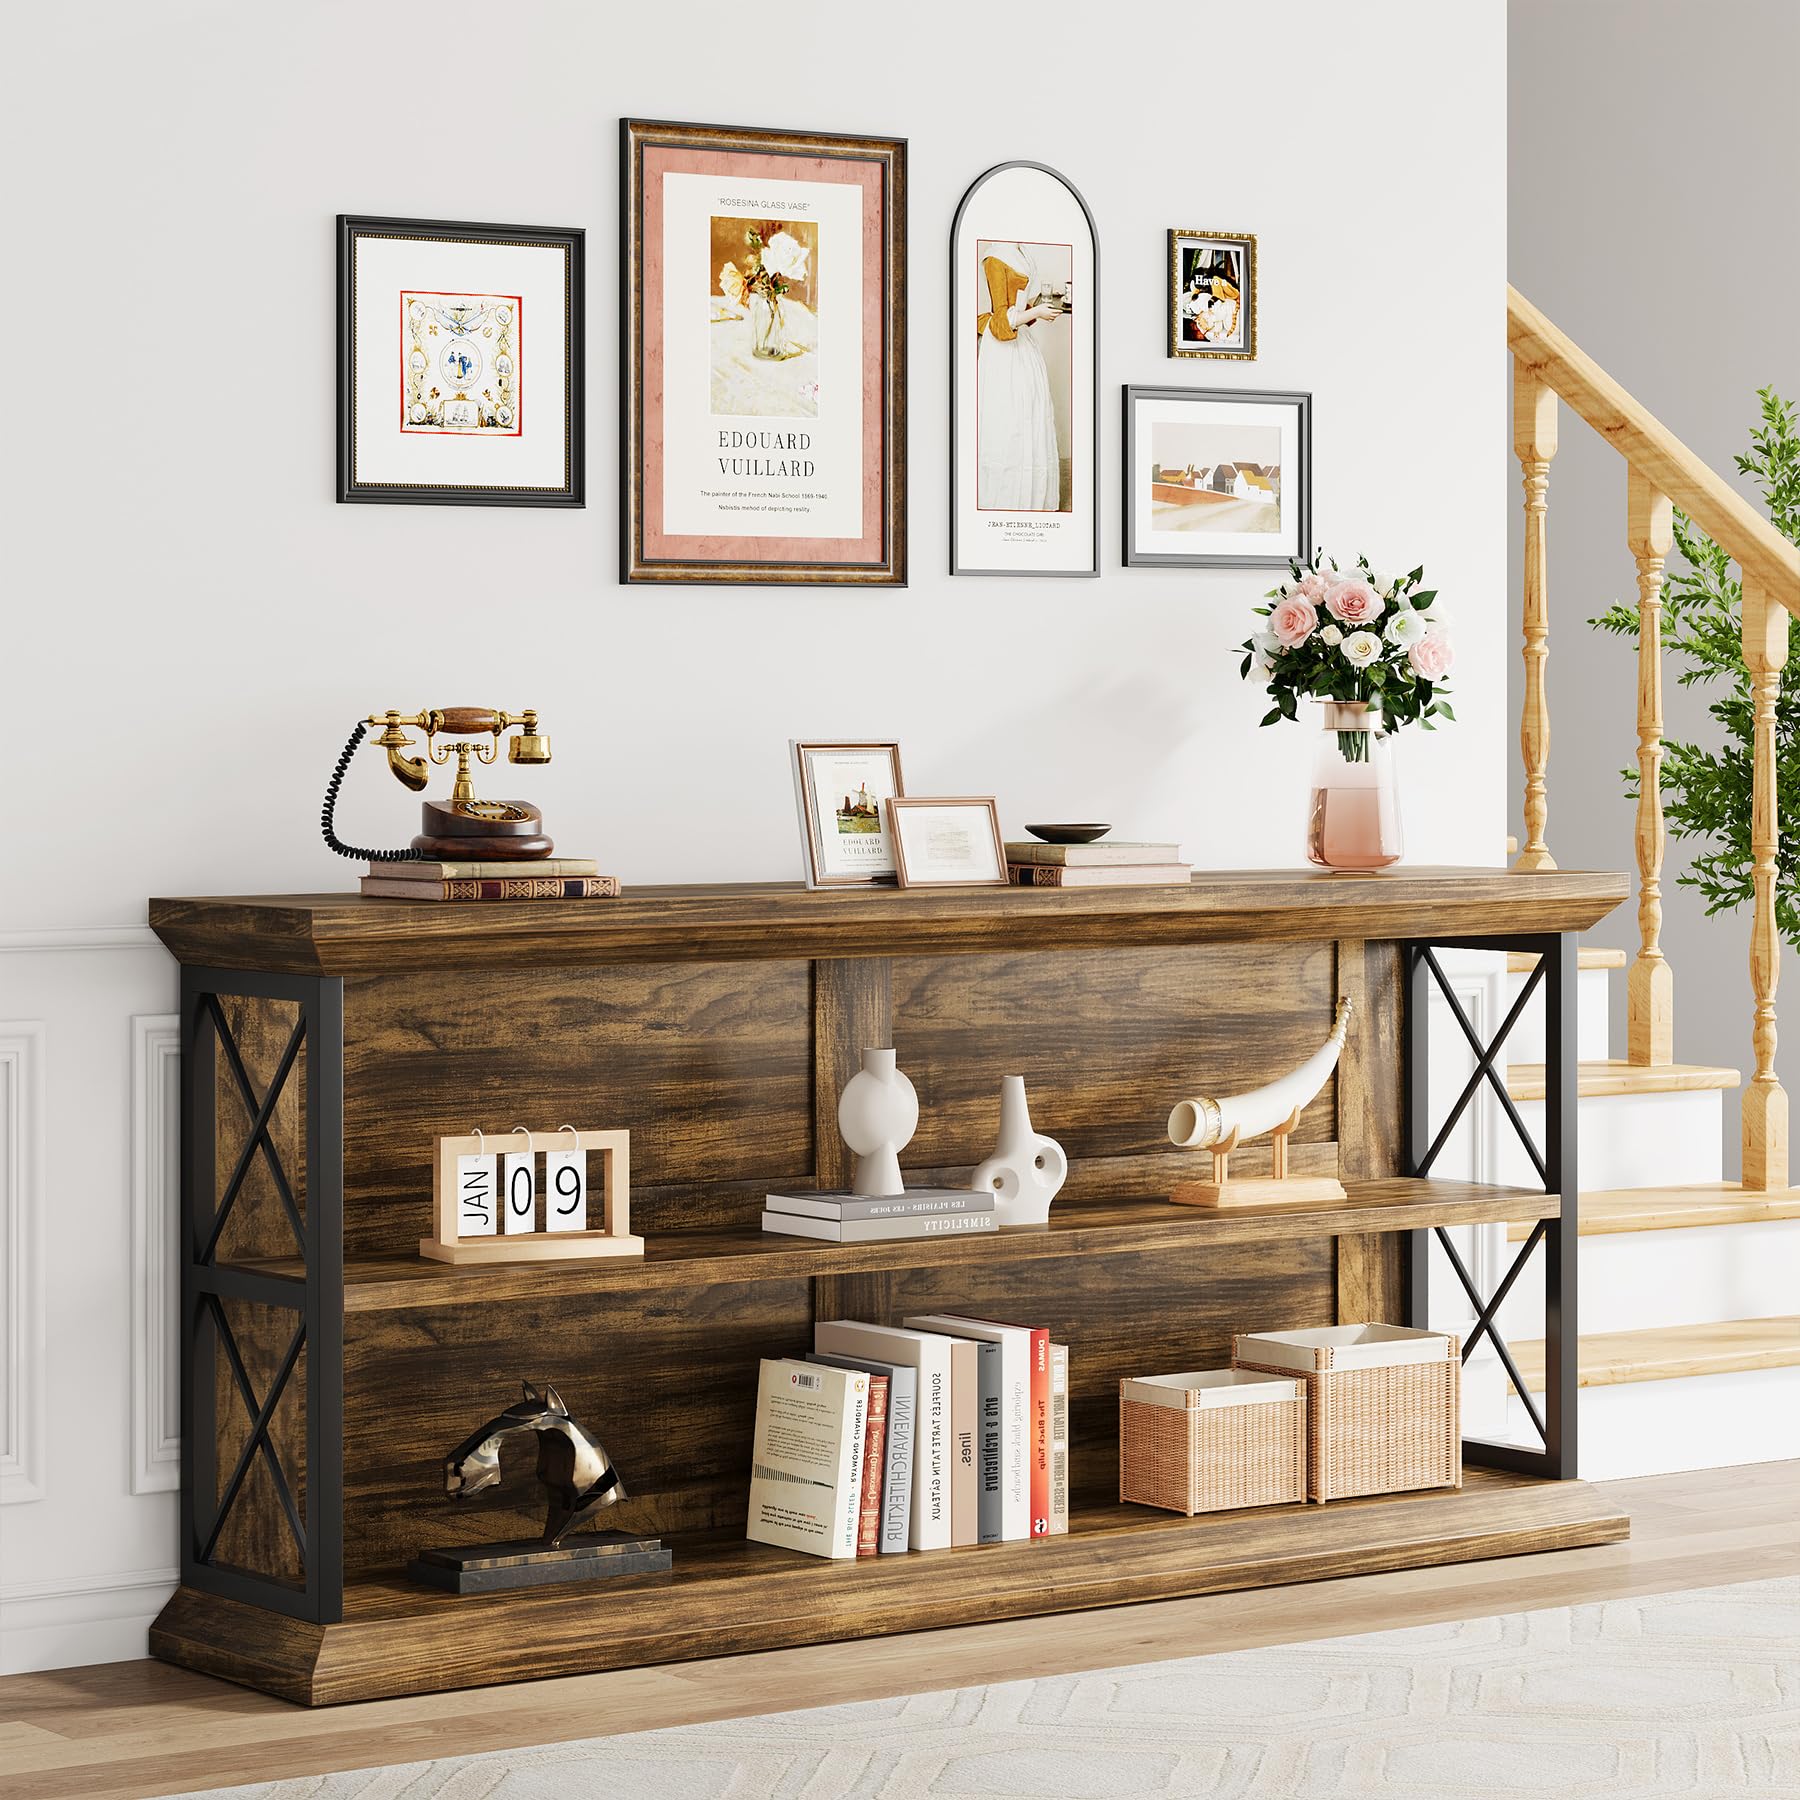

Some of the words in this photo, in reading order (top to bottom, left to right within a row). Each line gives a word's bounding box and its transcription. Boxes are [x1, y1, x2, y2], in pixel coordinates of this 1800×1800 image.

[760, 200, 786, 209] GLASS
[718, 430, 811, 450] EDOUARD
[718, 457, 815, 477] VUILLARD
[843, 838, 881, 846] EDOUARD
[843, 847, 883, 855] VUILLARD
[463, 1171, 489, 1226] JAN
